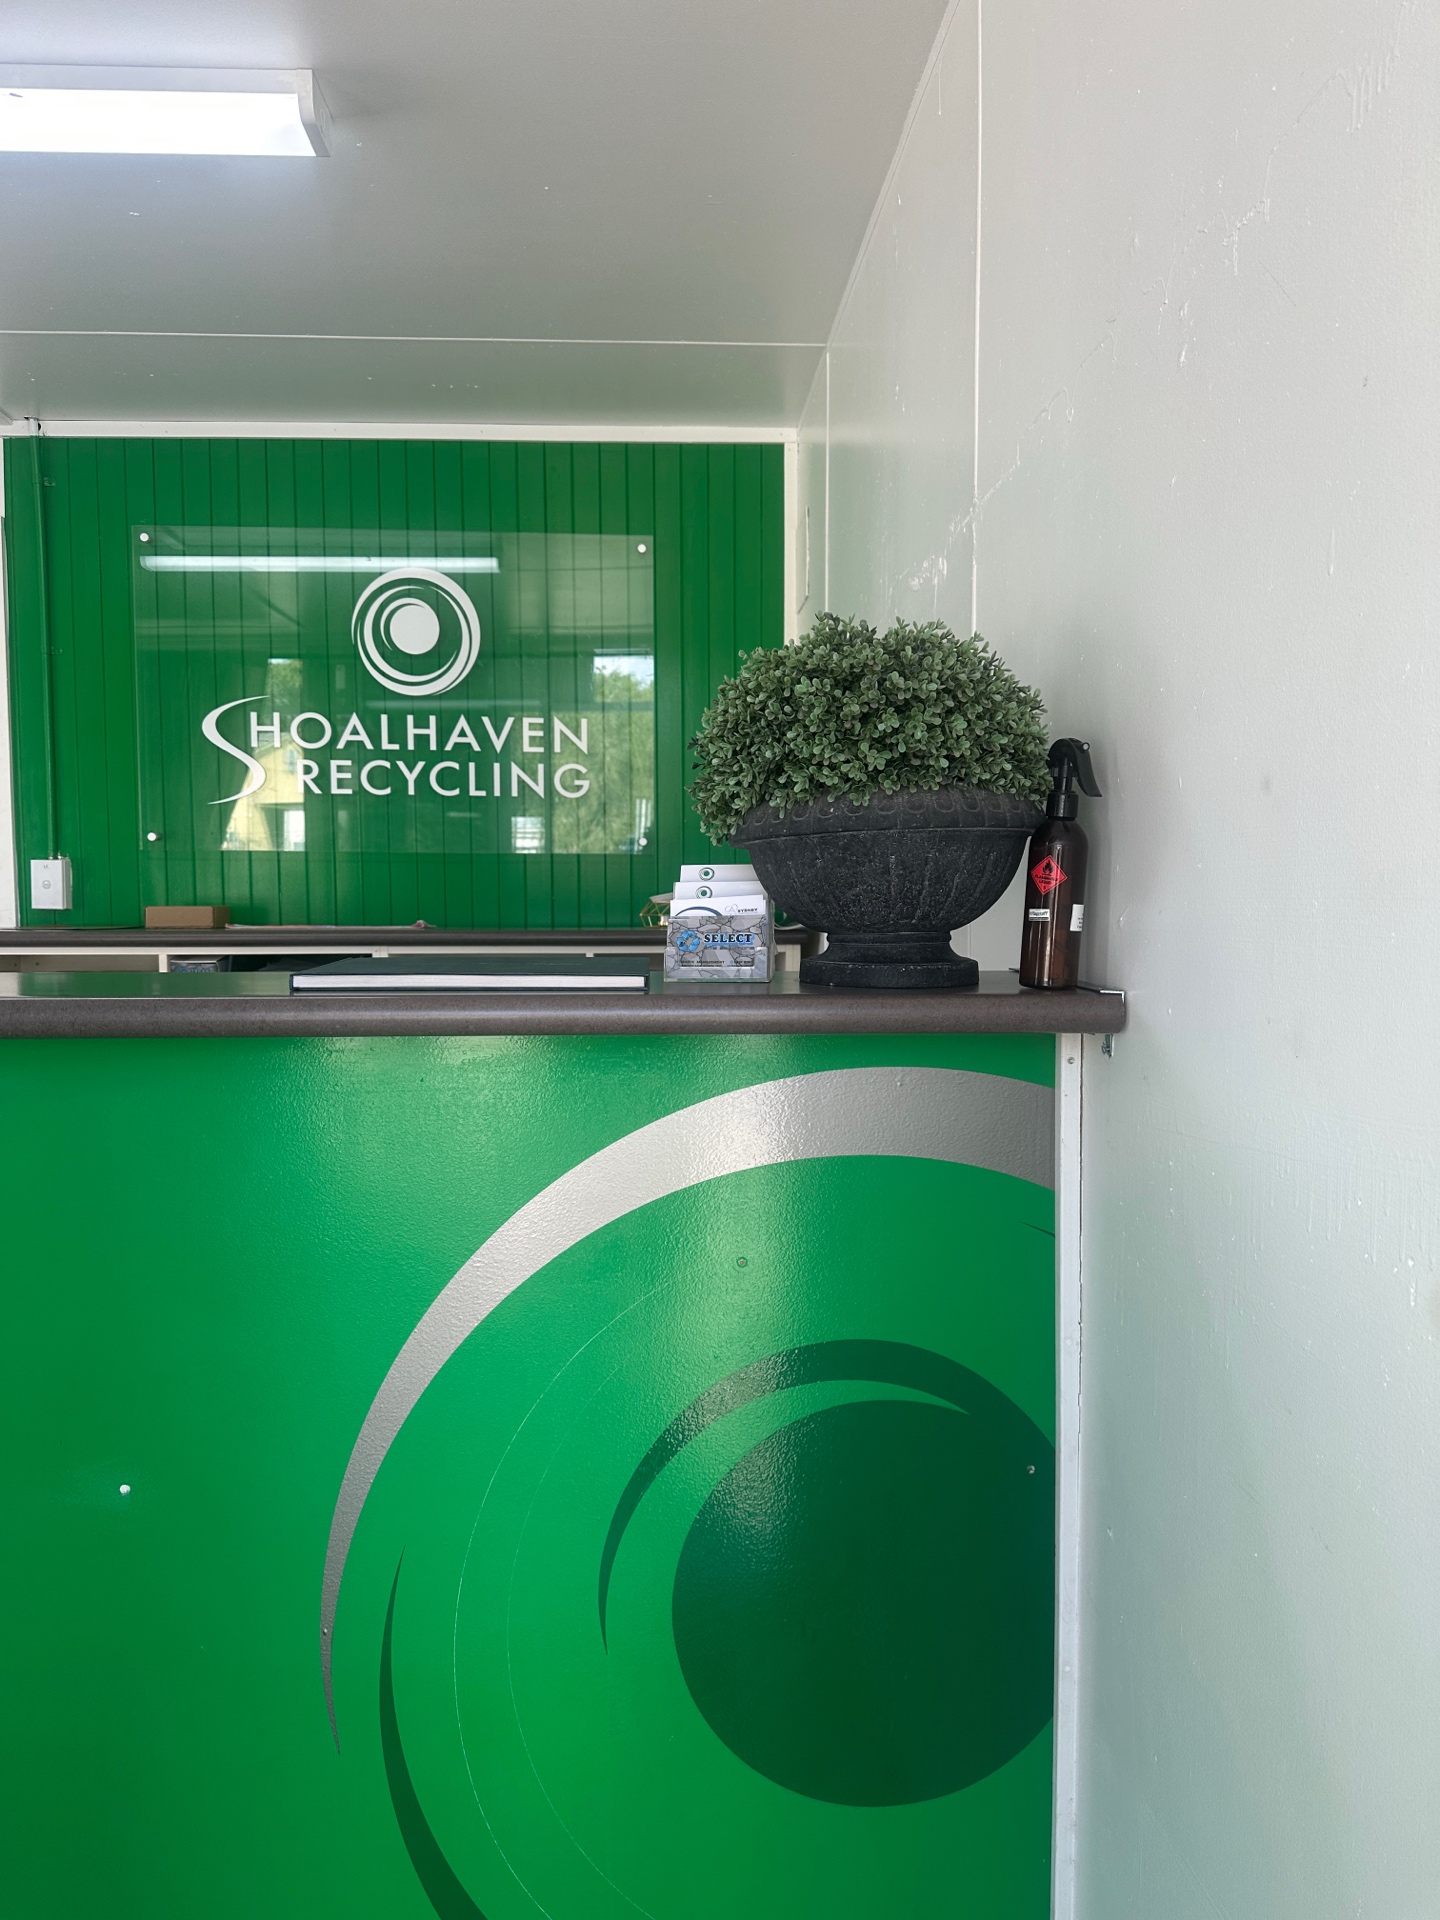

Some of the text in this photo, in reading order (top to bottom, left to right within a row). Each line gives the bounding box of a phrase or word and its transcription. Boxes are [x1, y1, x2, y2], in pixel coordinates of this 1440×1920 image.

[201, 695, 589, 805] SHOALHAVEN
[296, 759, 590, 799] RECYCLING
[703, 933, 753, 944] SELECT
